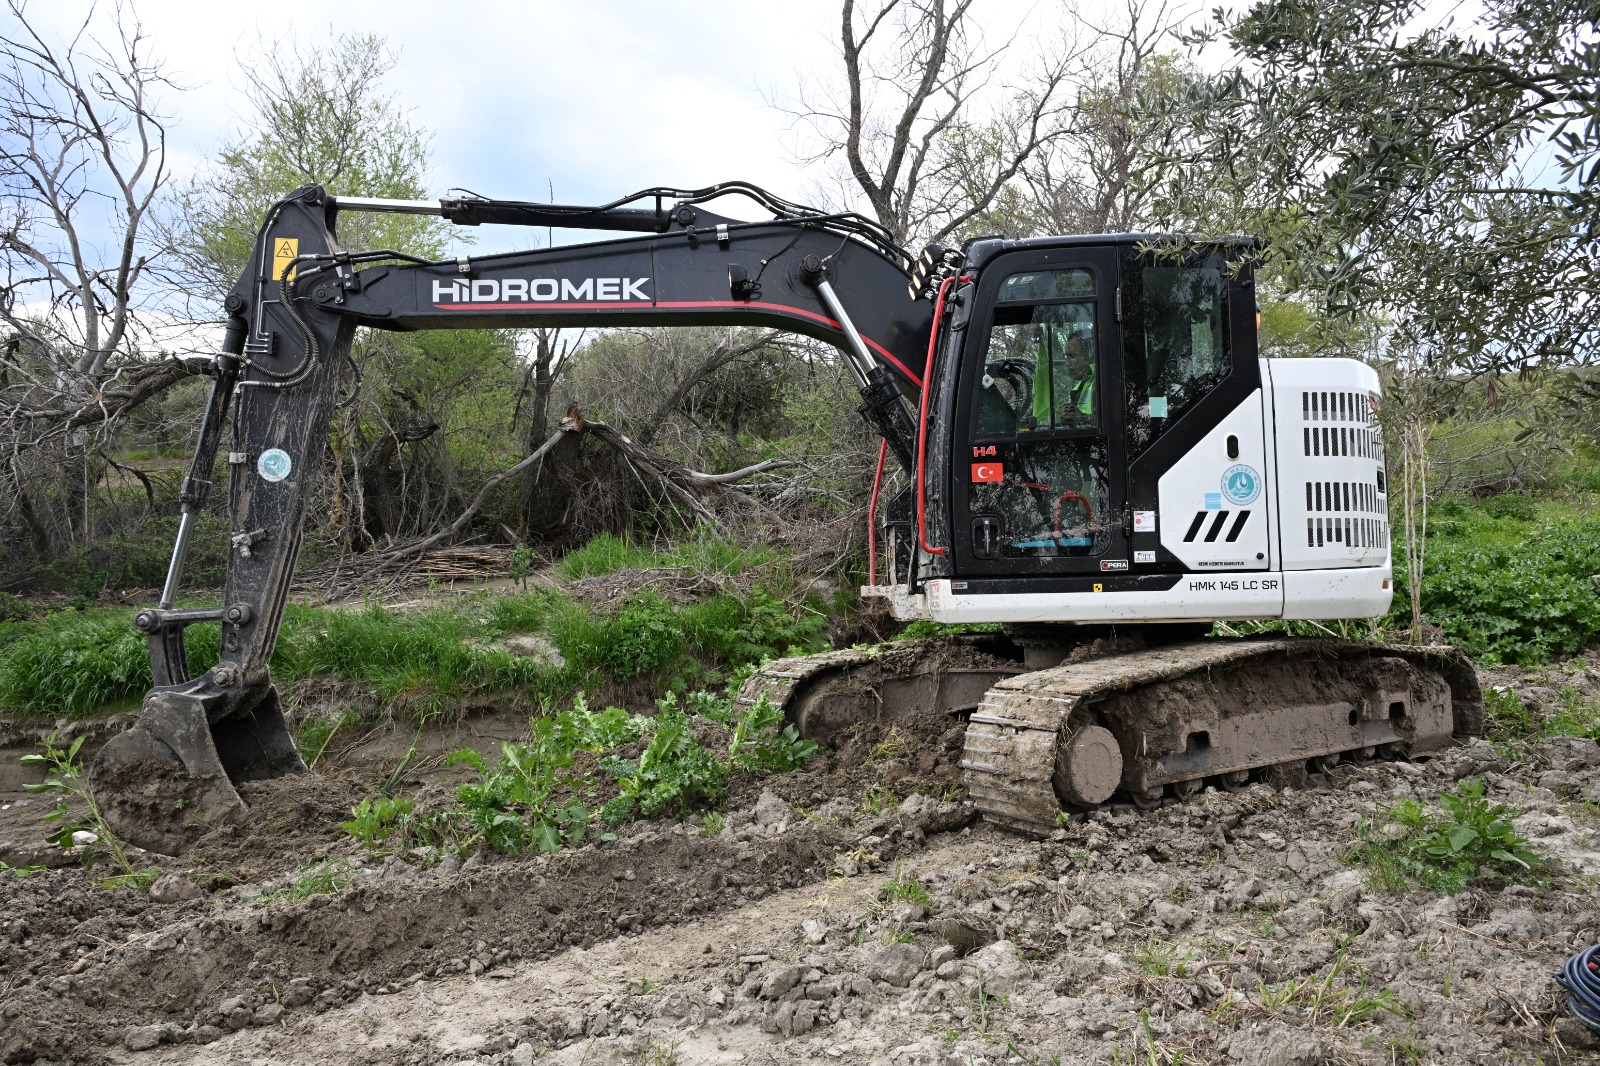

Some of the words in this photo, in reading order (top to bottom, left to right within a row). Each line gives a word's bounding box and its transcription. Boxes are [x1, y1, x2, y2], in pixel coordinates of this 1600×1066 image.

[973, 445, 997, 458] H4
[1102, 561, 1127, 569] OPERA
[1189, 582, 1216, 591] HMK
[1220, 581, 1239, 591] 145
[1243, 580, 1258, 590] LC
[1262, 580, 1278, 590] SR
